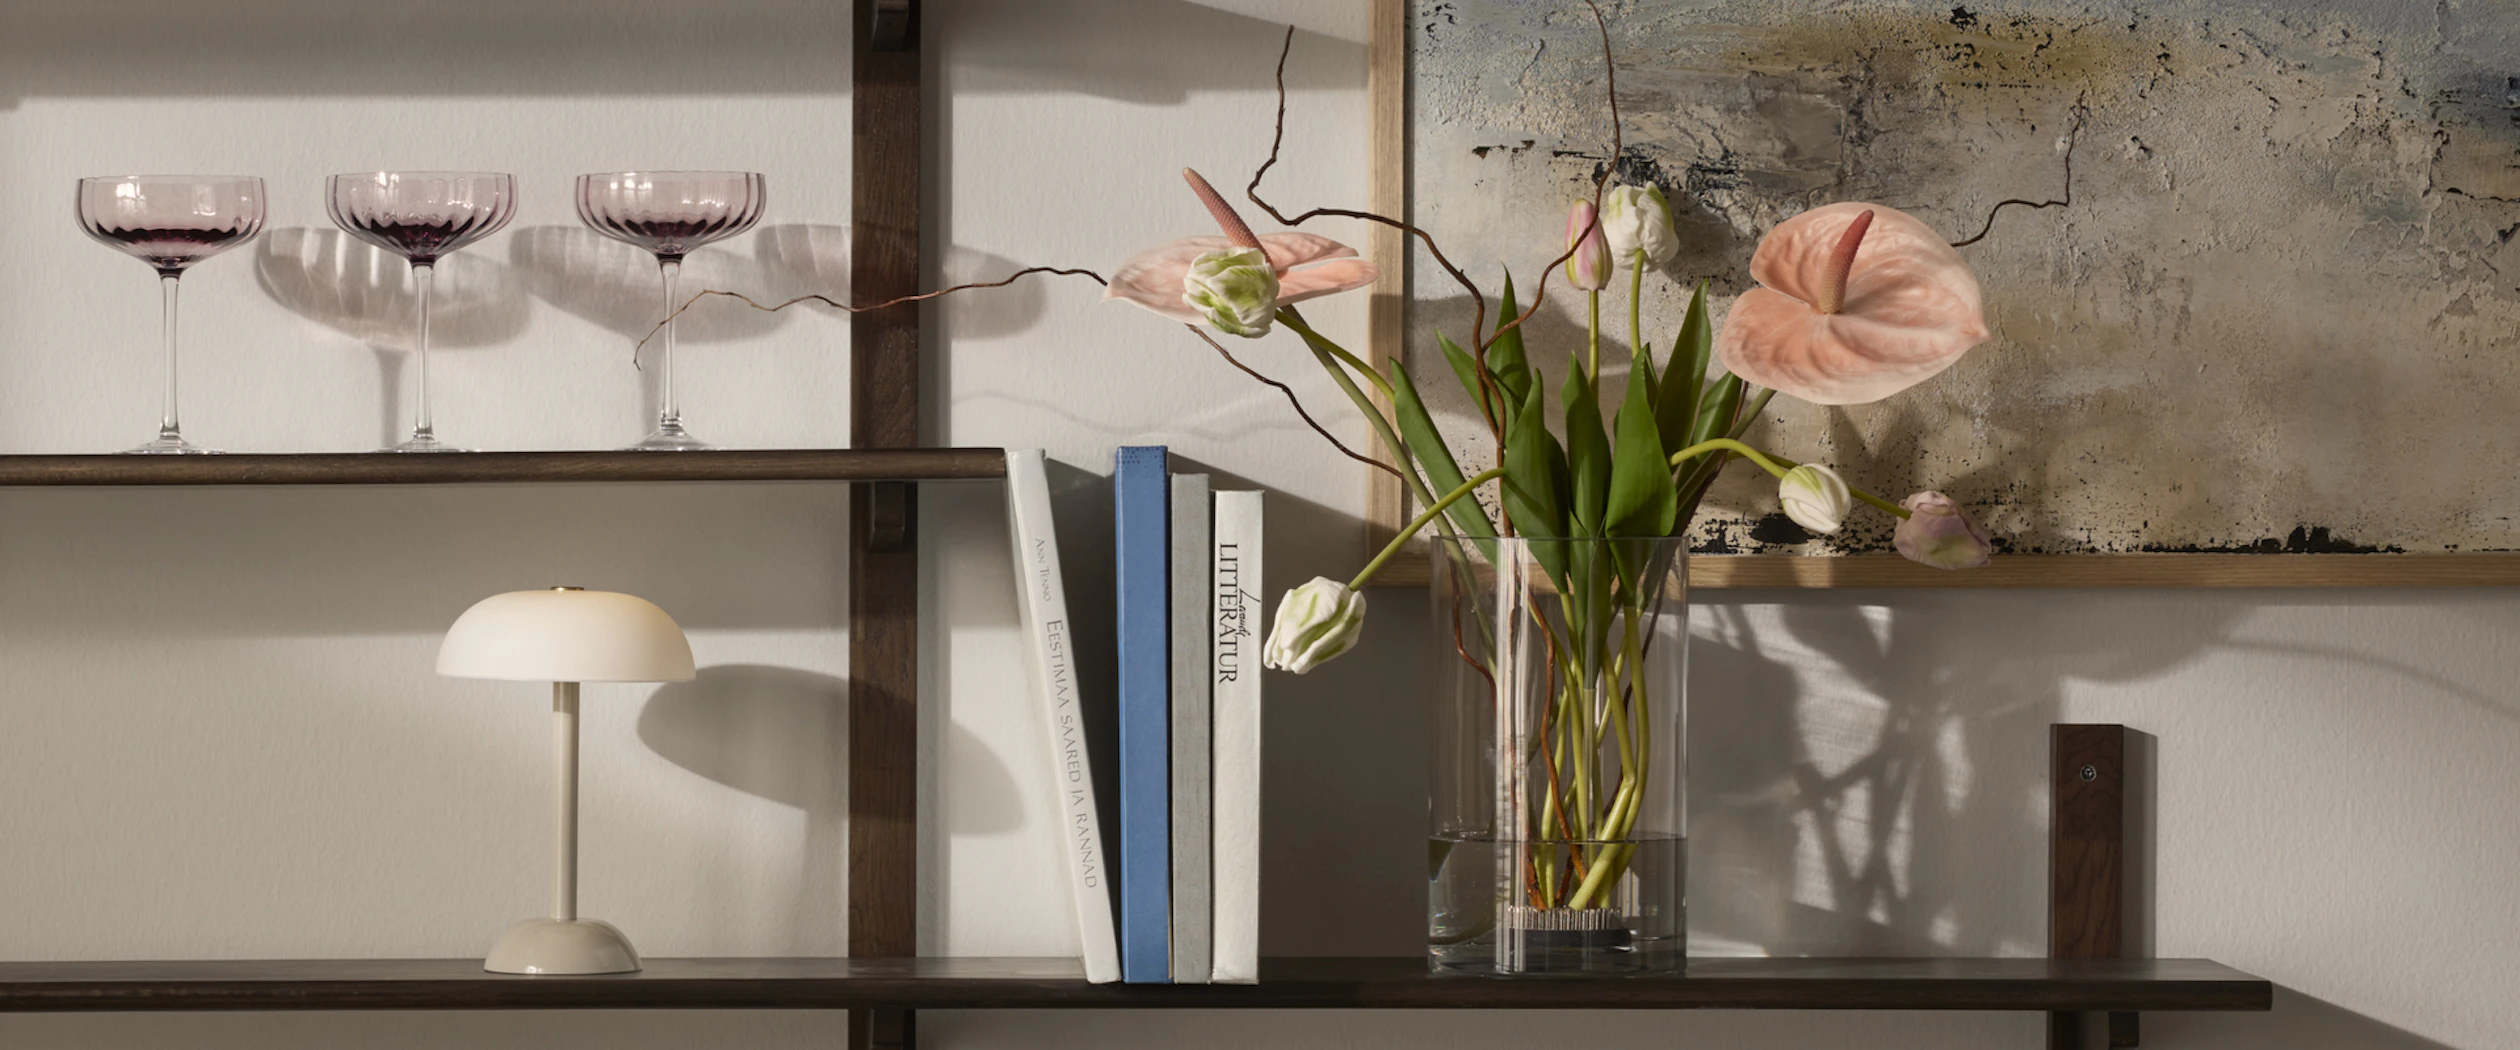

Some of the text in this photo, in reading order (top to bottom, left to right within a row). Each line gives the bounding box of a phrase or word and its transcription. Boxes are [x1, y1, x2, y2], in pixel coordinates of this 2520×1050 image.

[1219, 544, 1238, 683] LITTERATUR
[1047, 620, 1070, 708] EESTIMAA
[1060, 715, 1081, 782] SAARED
[1076, 813, 1097, 888] RANNAD
